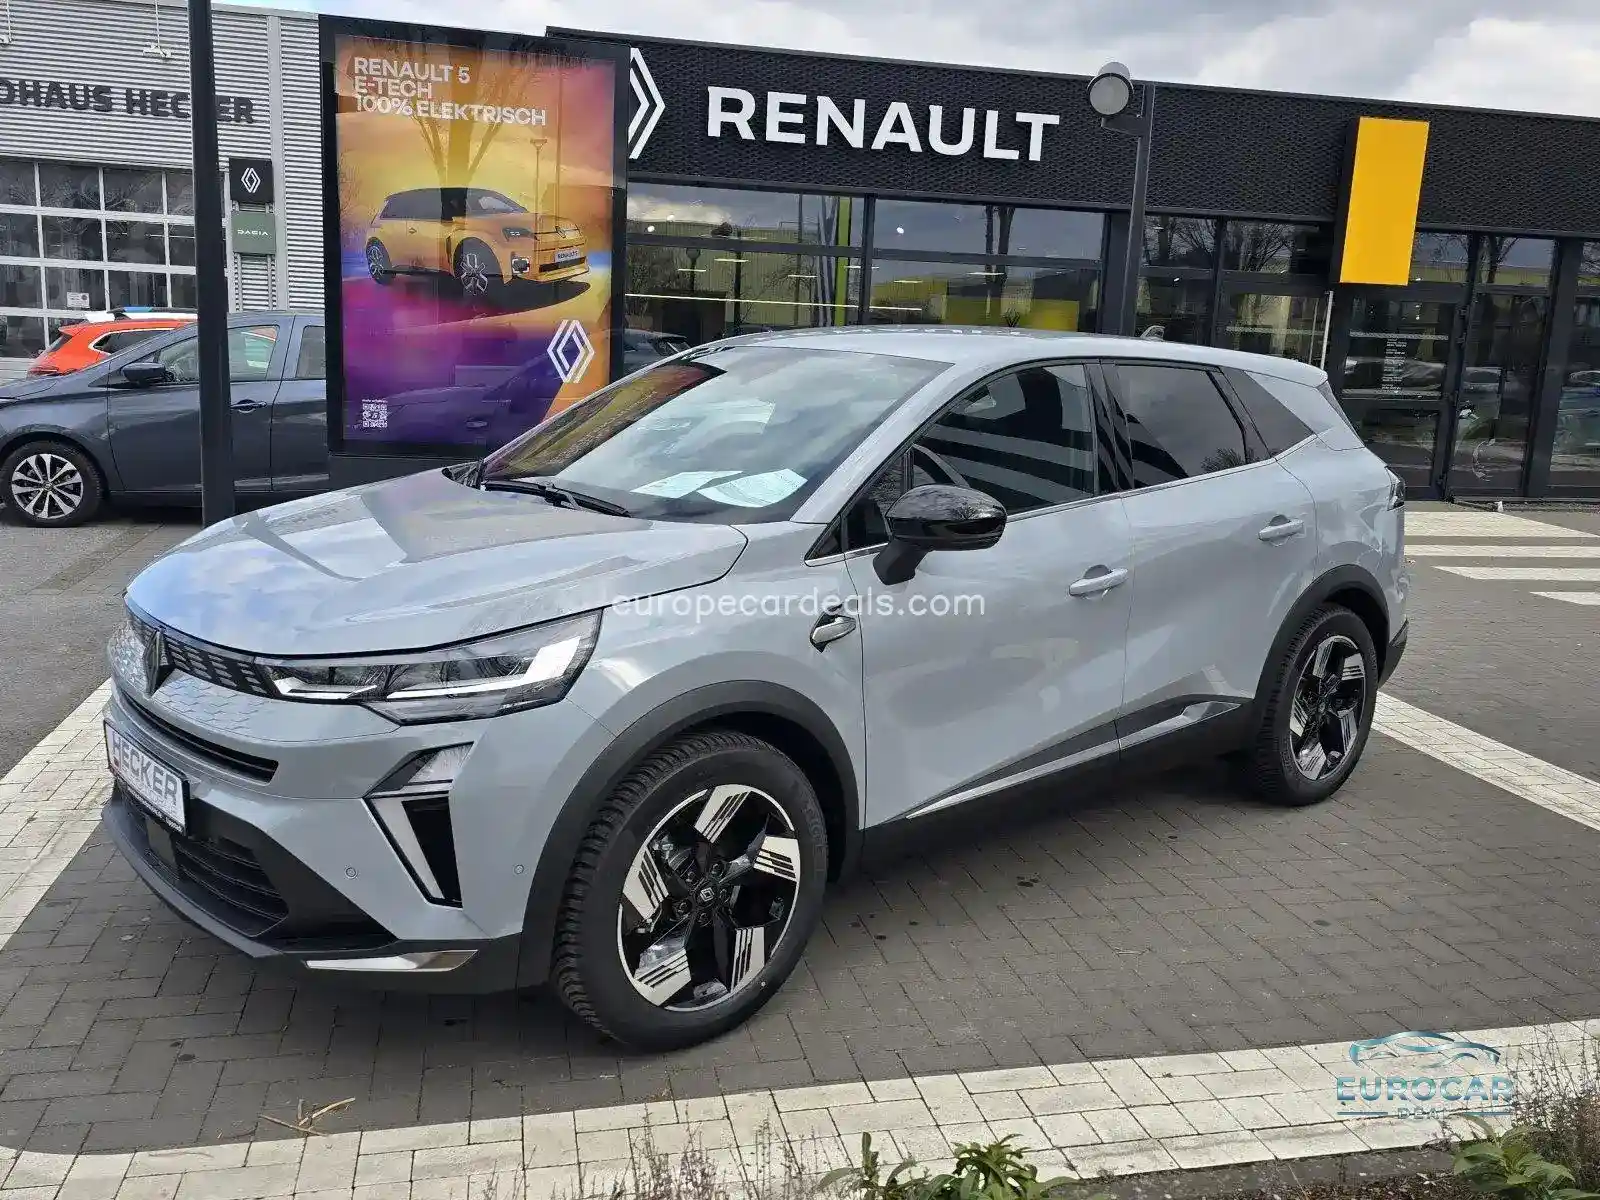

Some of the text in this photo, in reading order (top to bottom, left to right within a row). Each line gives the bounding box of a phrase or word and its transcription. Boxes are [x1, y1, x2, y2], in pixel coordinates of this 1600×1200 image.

[354, 56, 471, 84] RENAULT 5
[354, 76, 432, 99] E-TECH
[126, 87, 254, 123] HECER
[356, 95, 546, 126] 100% ELEKTRISCH
[707, 86, 1060, 162] RENAULT
[112, 731, 178, 806] HECKER
